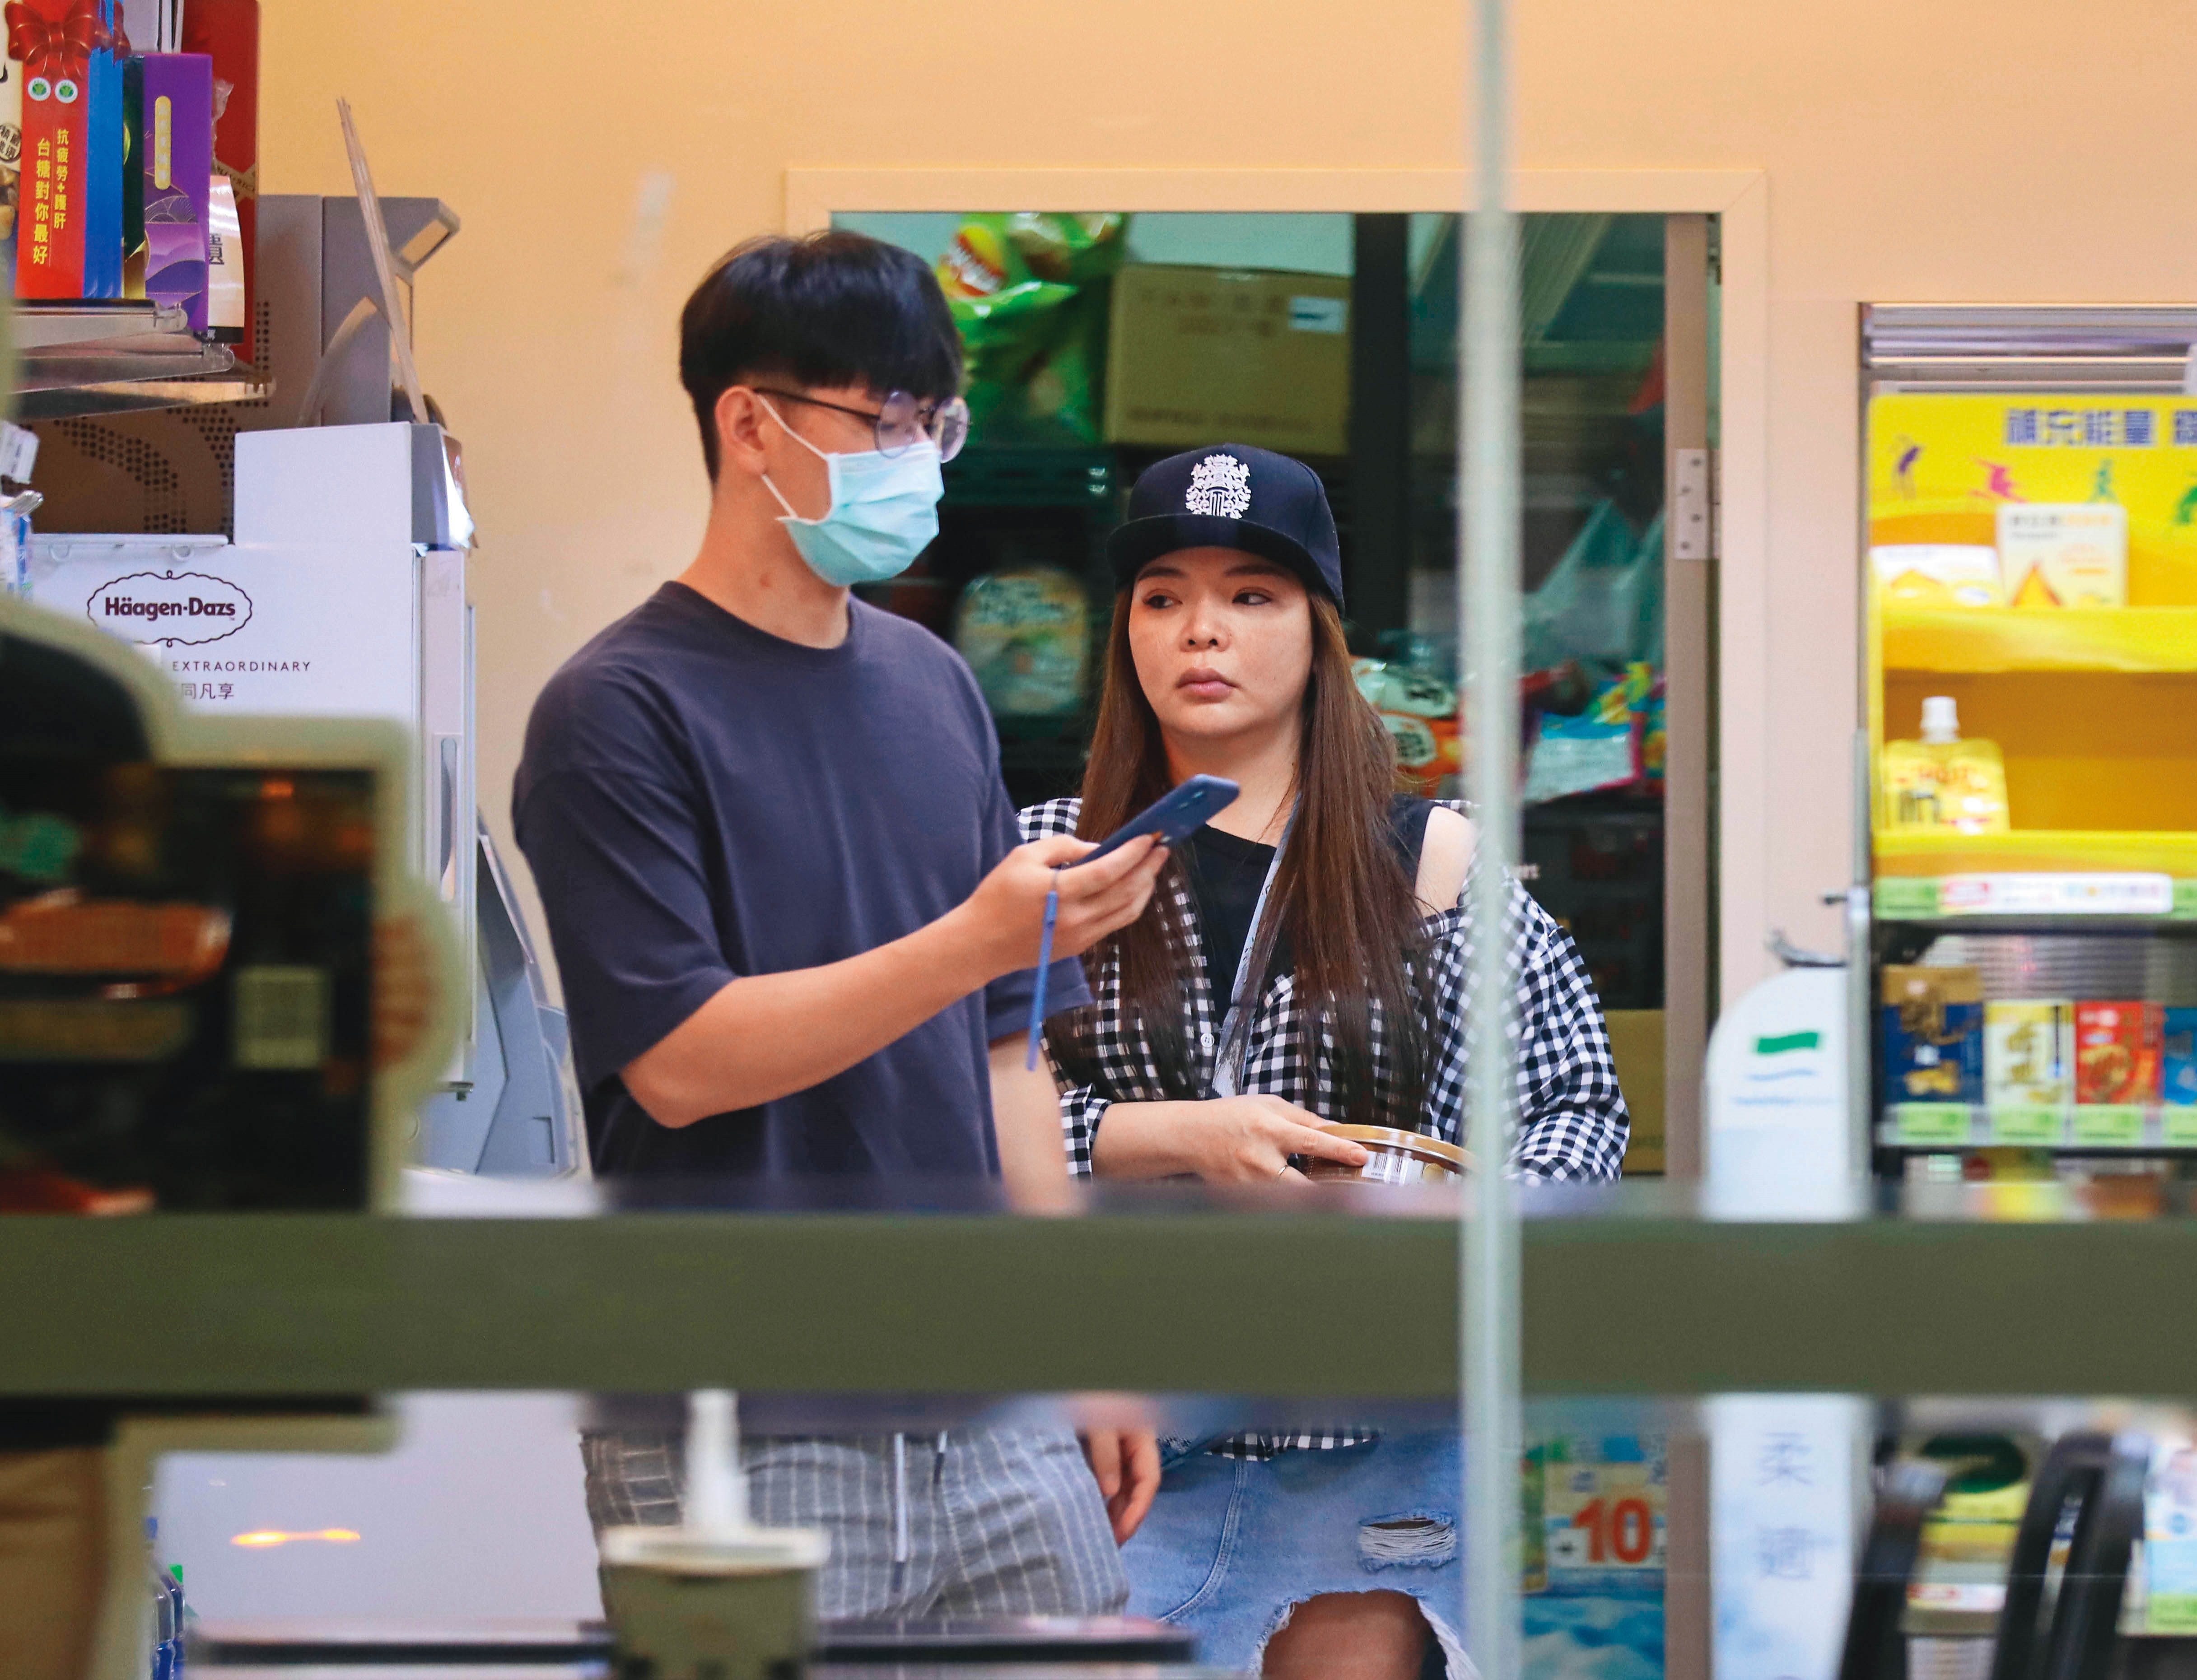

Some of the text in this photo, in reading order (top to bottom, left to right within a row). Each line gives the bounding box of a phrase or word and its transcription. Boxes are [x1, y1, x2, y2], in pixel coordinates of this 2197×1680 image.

[33, 137, 51, 265] 台糖對你最好
[105, 597, 235, 621] Häagen-Dazs
[173, 661, 311, 672] EXTRAORDINARY
[1572, 1499, 1652, 1563] 10
